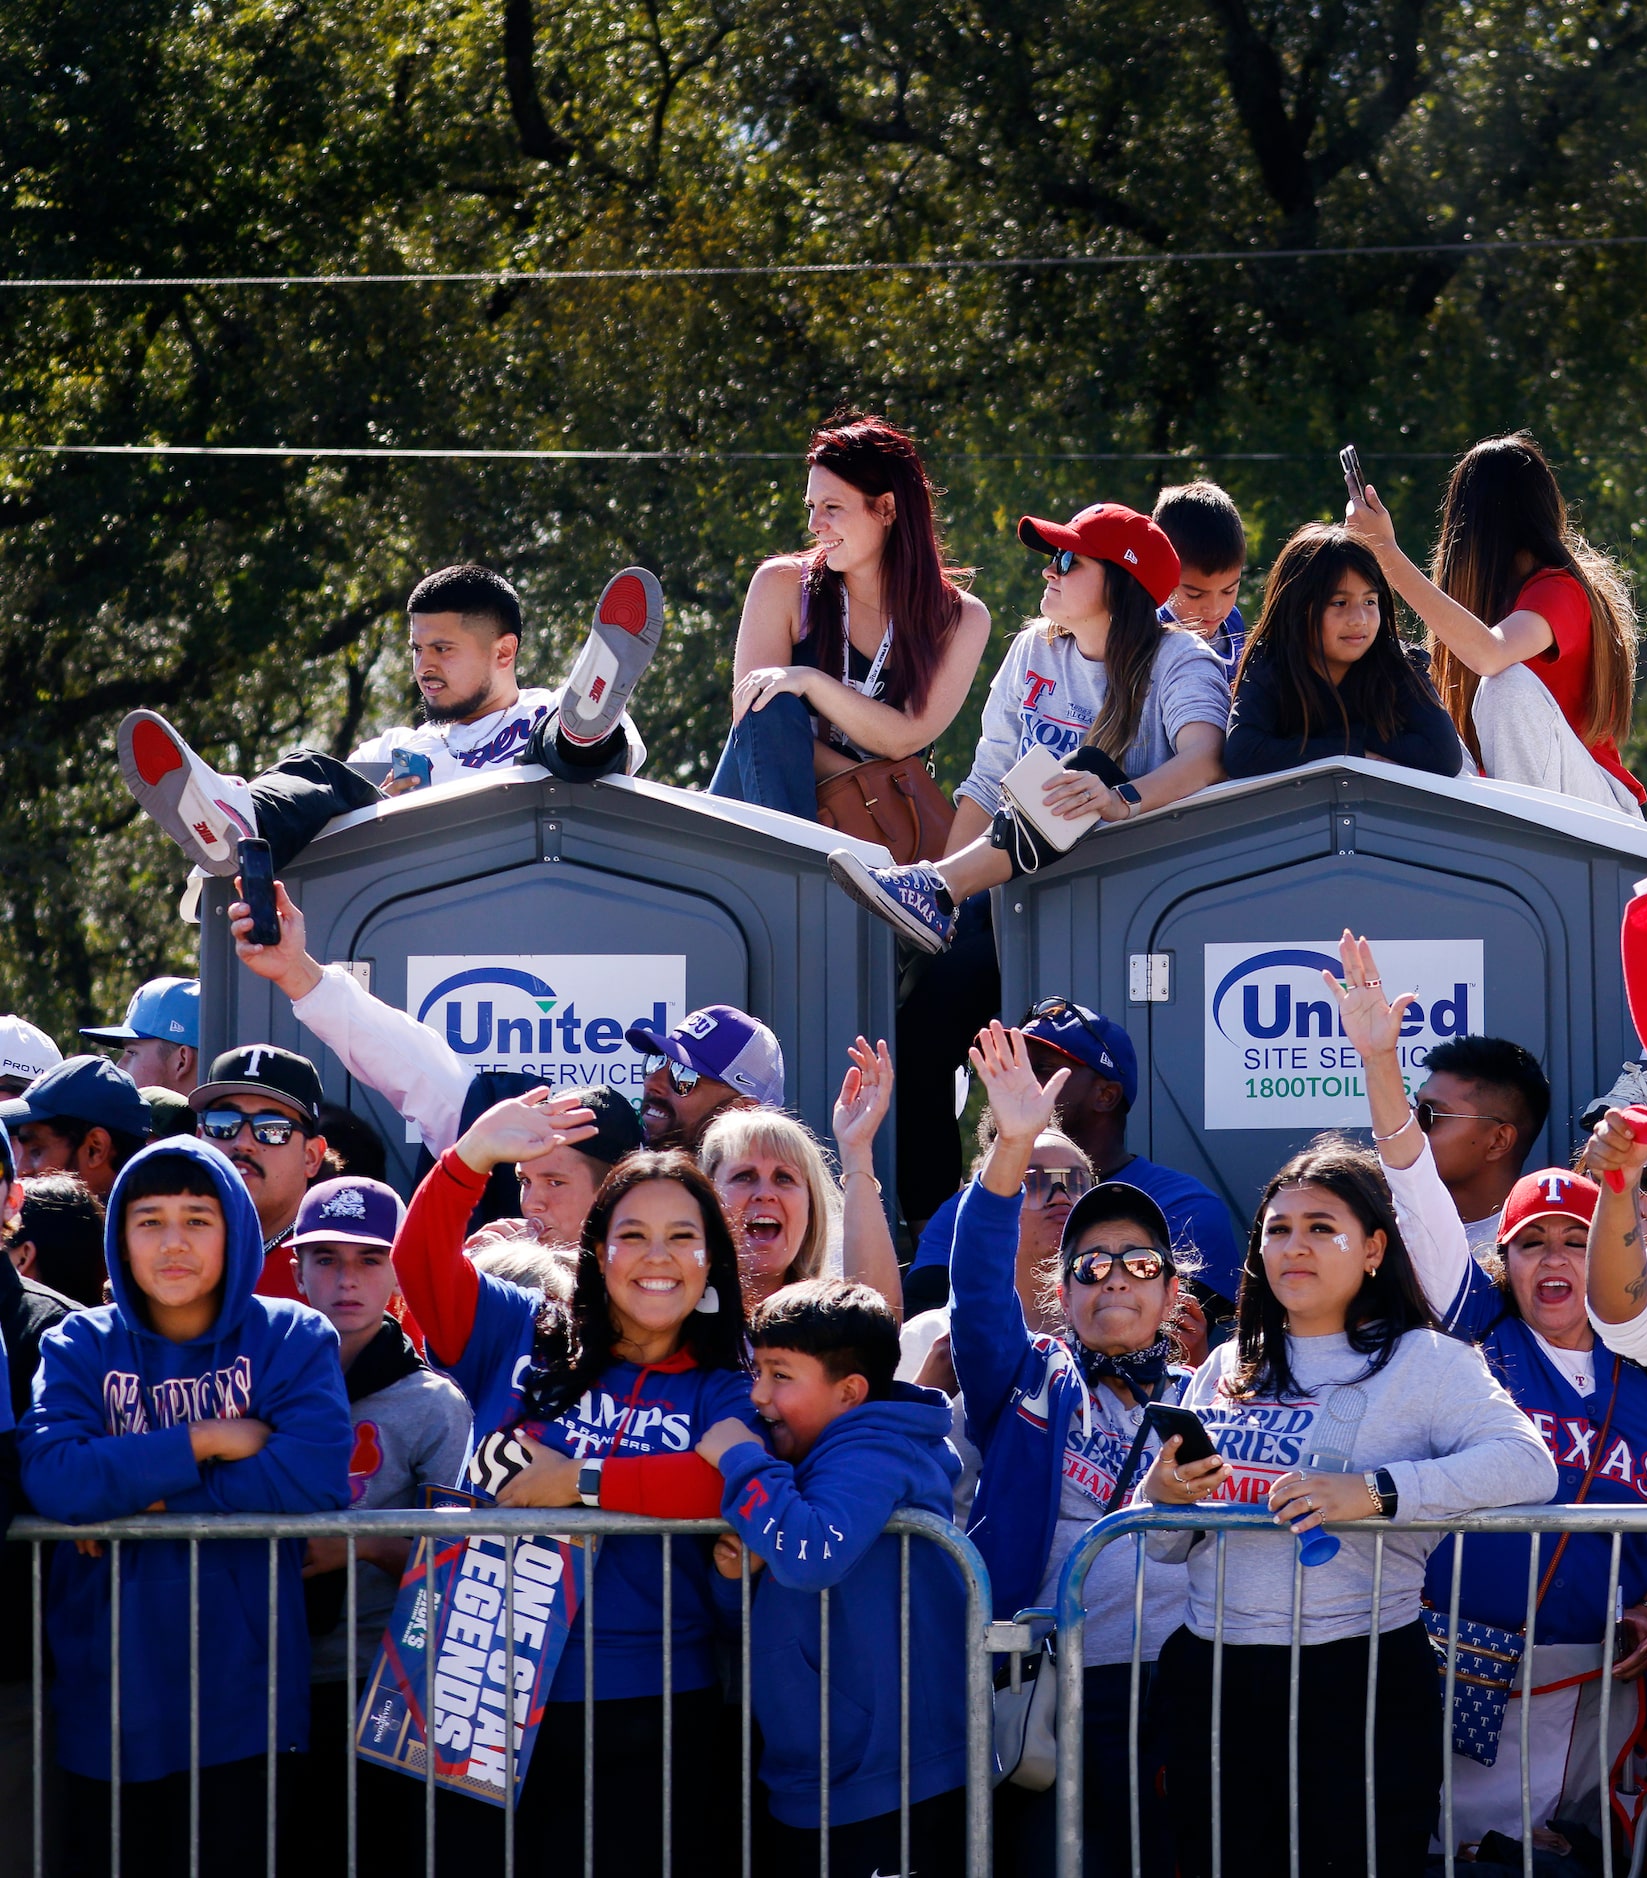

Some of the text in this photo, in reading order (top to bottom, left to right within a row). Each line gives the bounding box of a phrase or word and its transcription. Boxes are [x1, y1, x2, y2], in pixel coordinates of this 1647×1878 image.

[587, 675, 606, 704] NIKE
[1023, 669, 1057, 713] T
[1020, 711, 1079, 754] WOR
[192, 820, 218, 845] NIKE
[898, 887, 936, 924] TEXAS
[1243, 983, 1468, 1039] Uned
[446, 1001, 667, 1054] United
[3, 1059, 30, 1072] PRO
[239, 1048, 275, 1077] T
[521, 1063, 644, 1085] SERVICE
[1244, 1048, 1308, 1070] SITE
[1537, 1174, 1572, 1205] T
[1331, 1233, 1350, 1253] T
[1575, 1375, 1585, 1387] T
[578, 1426, 651, 1453] RANERS
[1210, 1429, 1306, 1467] RIES
[738, 1478, 769, 1522] T
[763, 1517, 844, 1560] TEXAS
[467, 1648, 536, 1788] STAR
